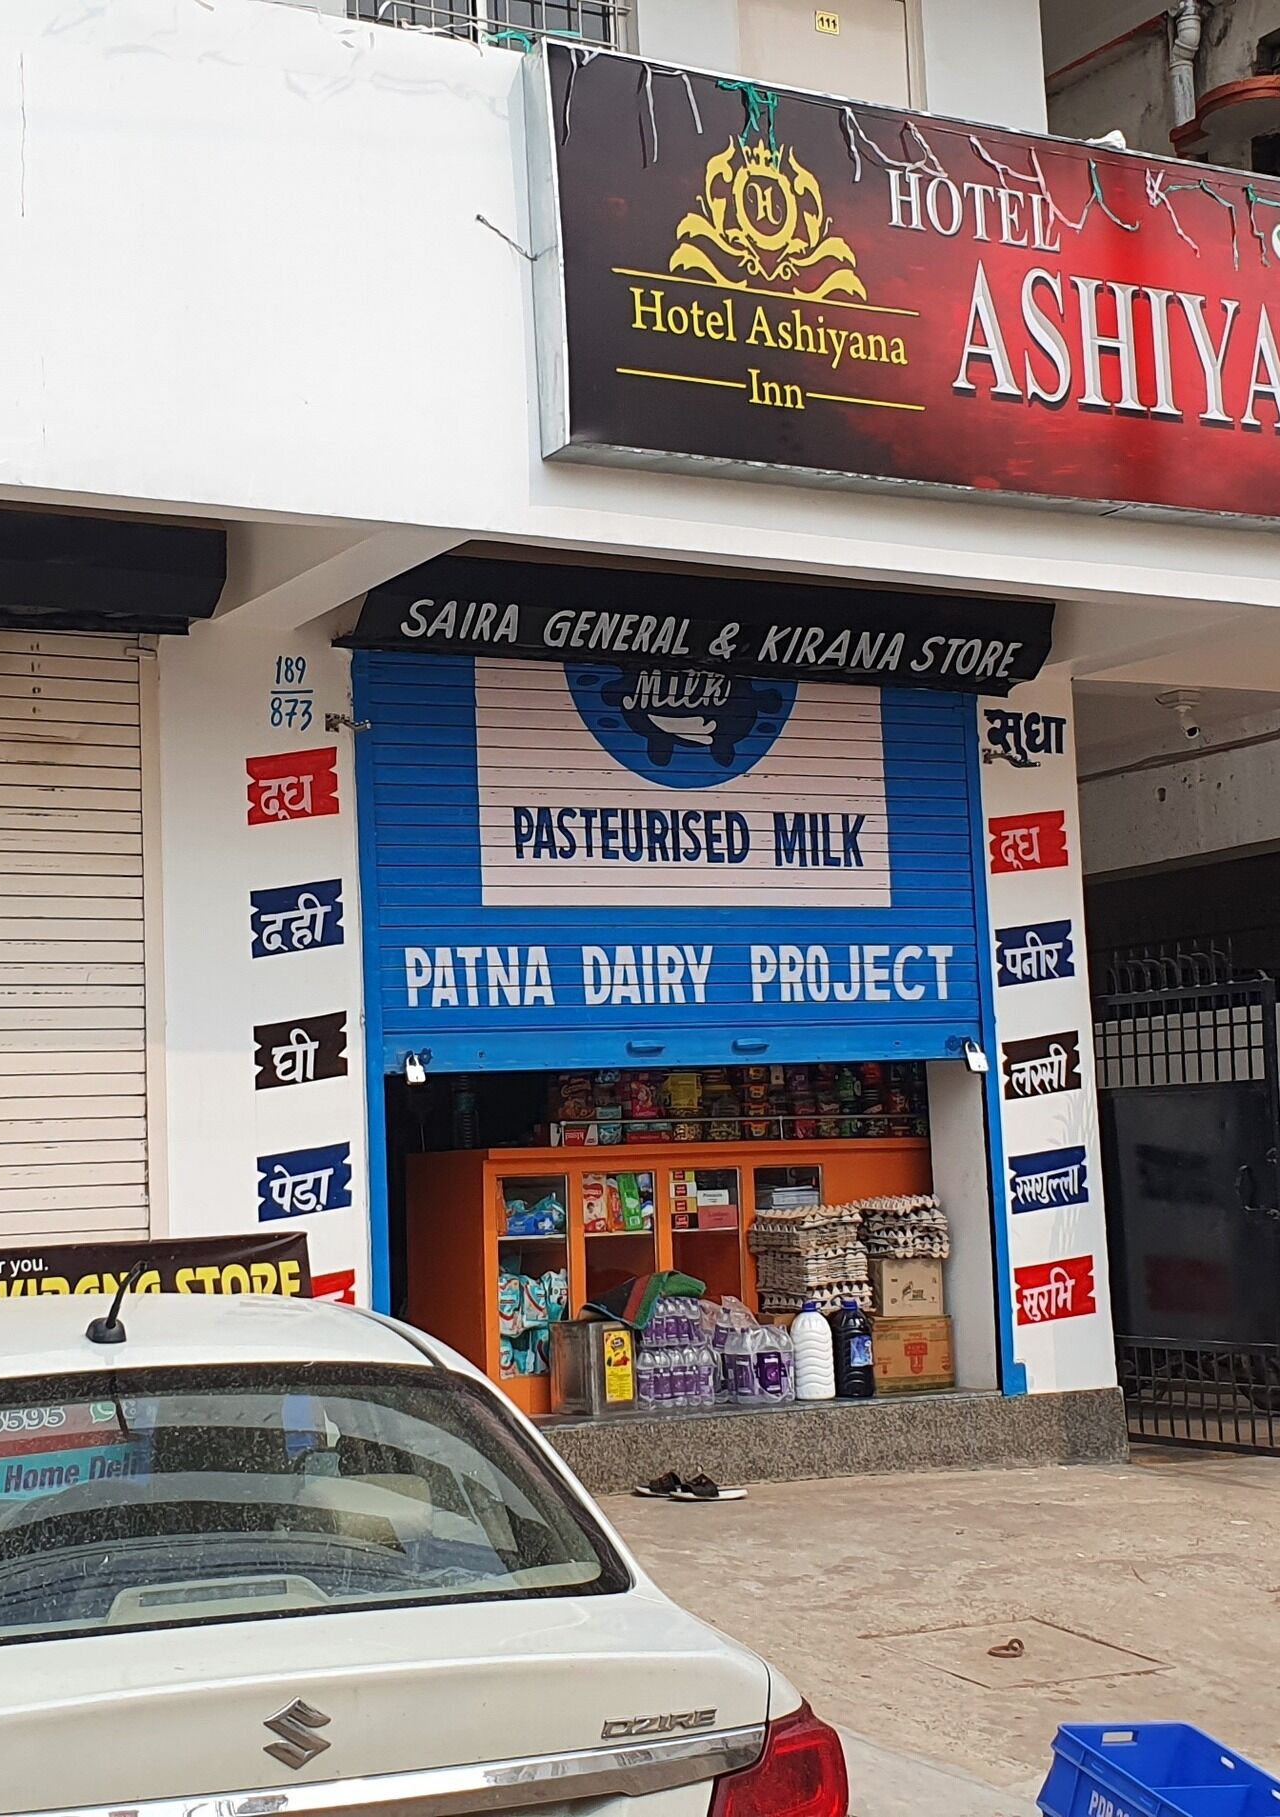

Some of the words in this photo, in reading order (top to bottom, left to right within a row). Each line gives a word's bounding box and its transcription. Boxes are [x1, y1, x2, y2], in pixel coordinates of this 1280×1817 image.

[885, 168, 1062, 254] HOTEL
[631, 287, 735, 342] Hotel
[747, 305, 908, 369] Ashiyana
[748, 368, 806, 410] Inn
[400, 598, 521, 644] SAIRA
[543, 608, 691, 659] GENERAL
[708, 621, 738, 660] &
[759, 623, 904, 675] KIRANA
[911, 636, 1023, 679] STORE
[275, 655, 307, 686] 189
[622, 668, 731, 711] Milk
[270, 696, 314, 732] 873
[984, 708, 1067, 762] सुधा
[513, 806, 751, 865] PASTEURISED
[774, 812, 865, 869] MILK
[1000, 826, 1041, 870] दूध
[260, 892, 332, 951] दही
[404, 944, 555, 1009] PATNA
[583, 943, 714, 1006] DAIRY
[751, 943, 954, 1004] PROJECT
[1003, 931, 1064, 981] पनीर
[271, 1027, 320, 1084] घी
[1010, 1042, 1068, 1096] लस्सी
[10, 1257, 49, 1280] you.
[1022, 1266, 1076, 1322] सुरभि
[4, 1461, 80, 1495] Home
[601, 1705, 718, 1740] DZIRE
